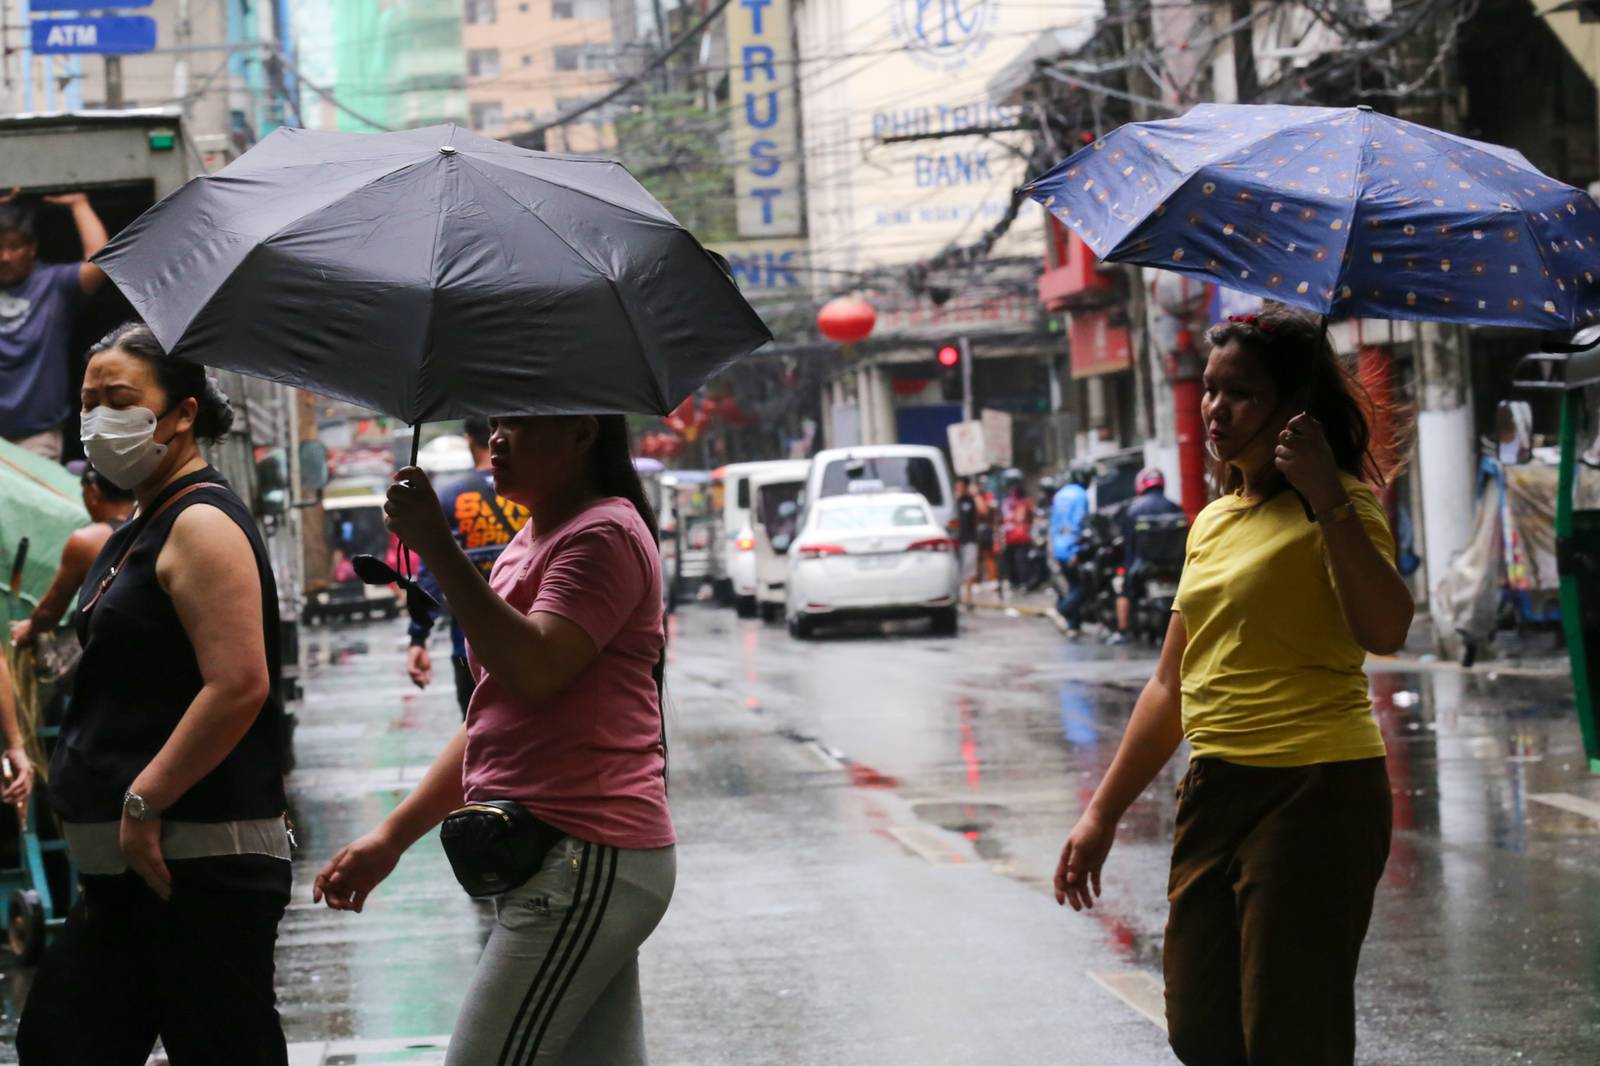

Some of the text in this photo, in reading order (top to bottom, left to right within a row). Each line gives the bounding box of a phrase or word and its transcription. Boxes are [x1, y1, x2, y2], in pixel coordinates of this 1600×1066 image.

[47, 24, 98, 47] ATM
[740, 0, 782, 225] TRUST
[915, 151, 992, 187] BANK
[730, 251, 799, 289] NK
